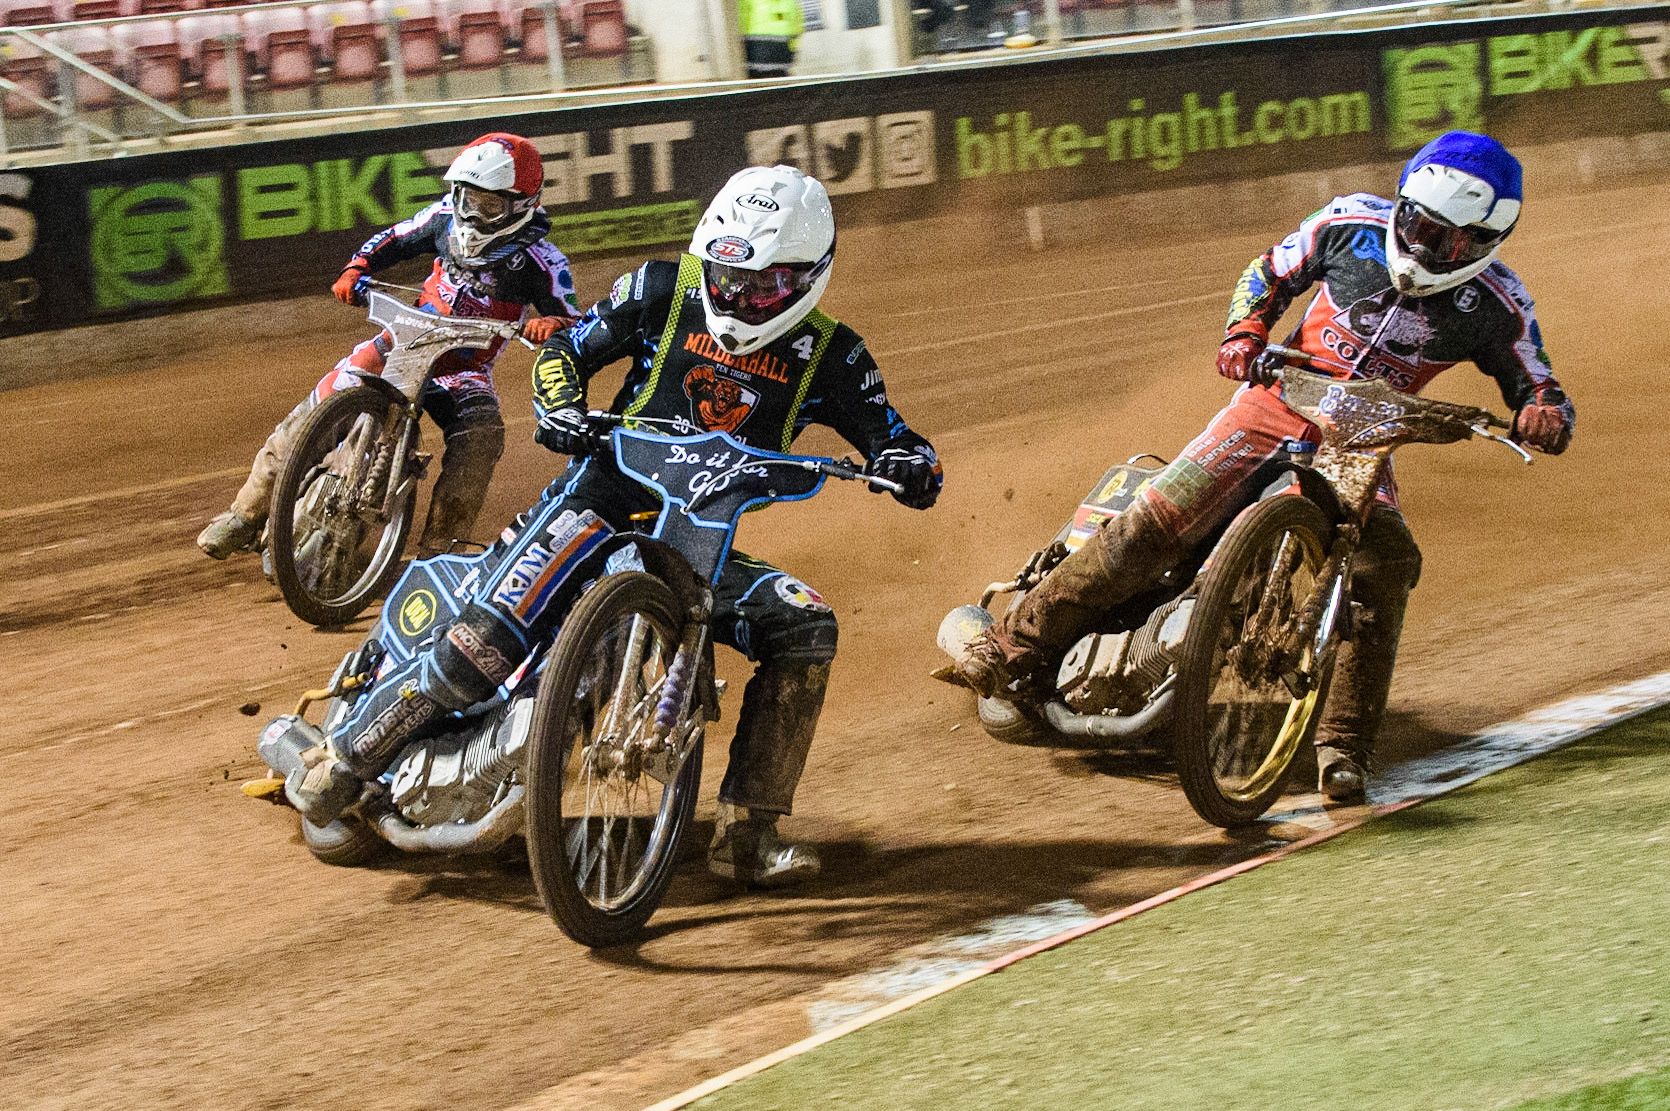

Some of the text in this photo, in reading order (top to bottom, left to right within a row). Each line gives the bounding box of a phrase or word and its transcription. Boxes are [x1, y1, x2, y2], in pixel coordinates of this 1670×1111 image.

[955, 90, 1371, 180] bike-right.com
[713, 242, 747, 256] STS
[791, 334, 814, 360] 4
[665, 445, 701, 464] Do
[706, 452, 731, 468] it
[1197, 429, 1247, 467] Services
[552, 512, 595, 550] SWEEPERS
[497, 547, 552, 606] KJM
